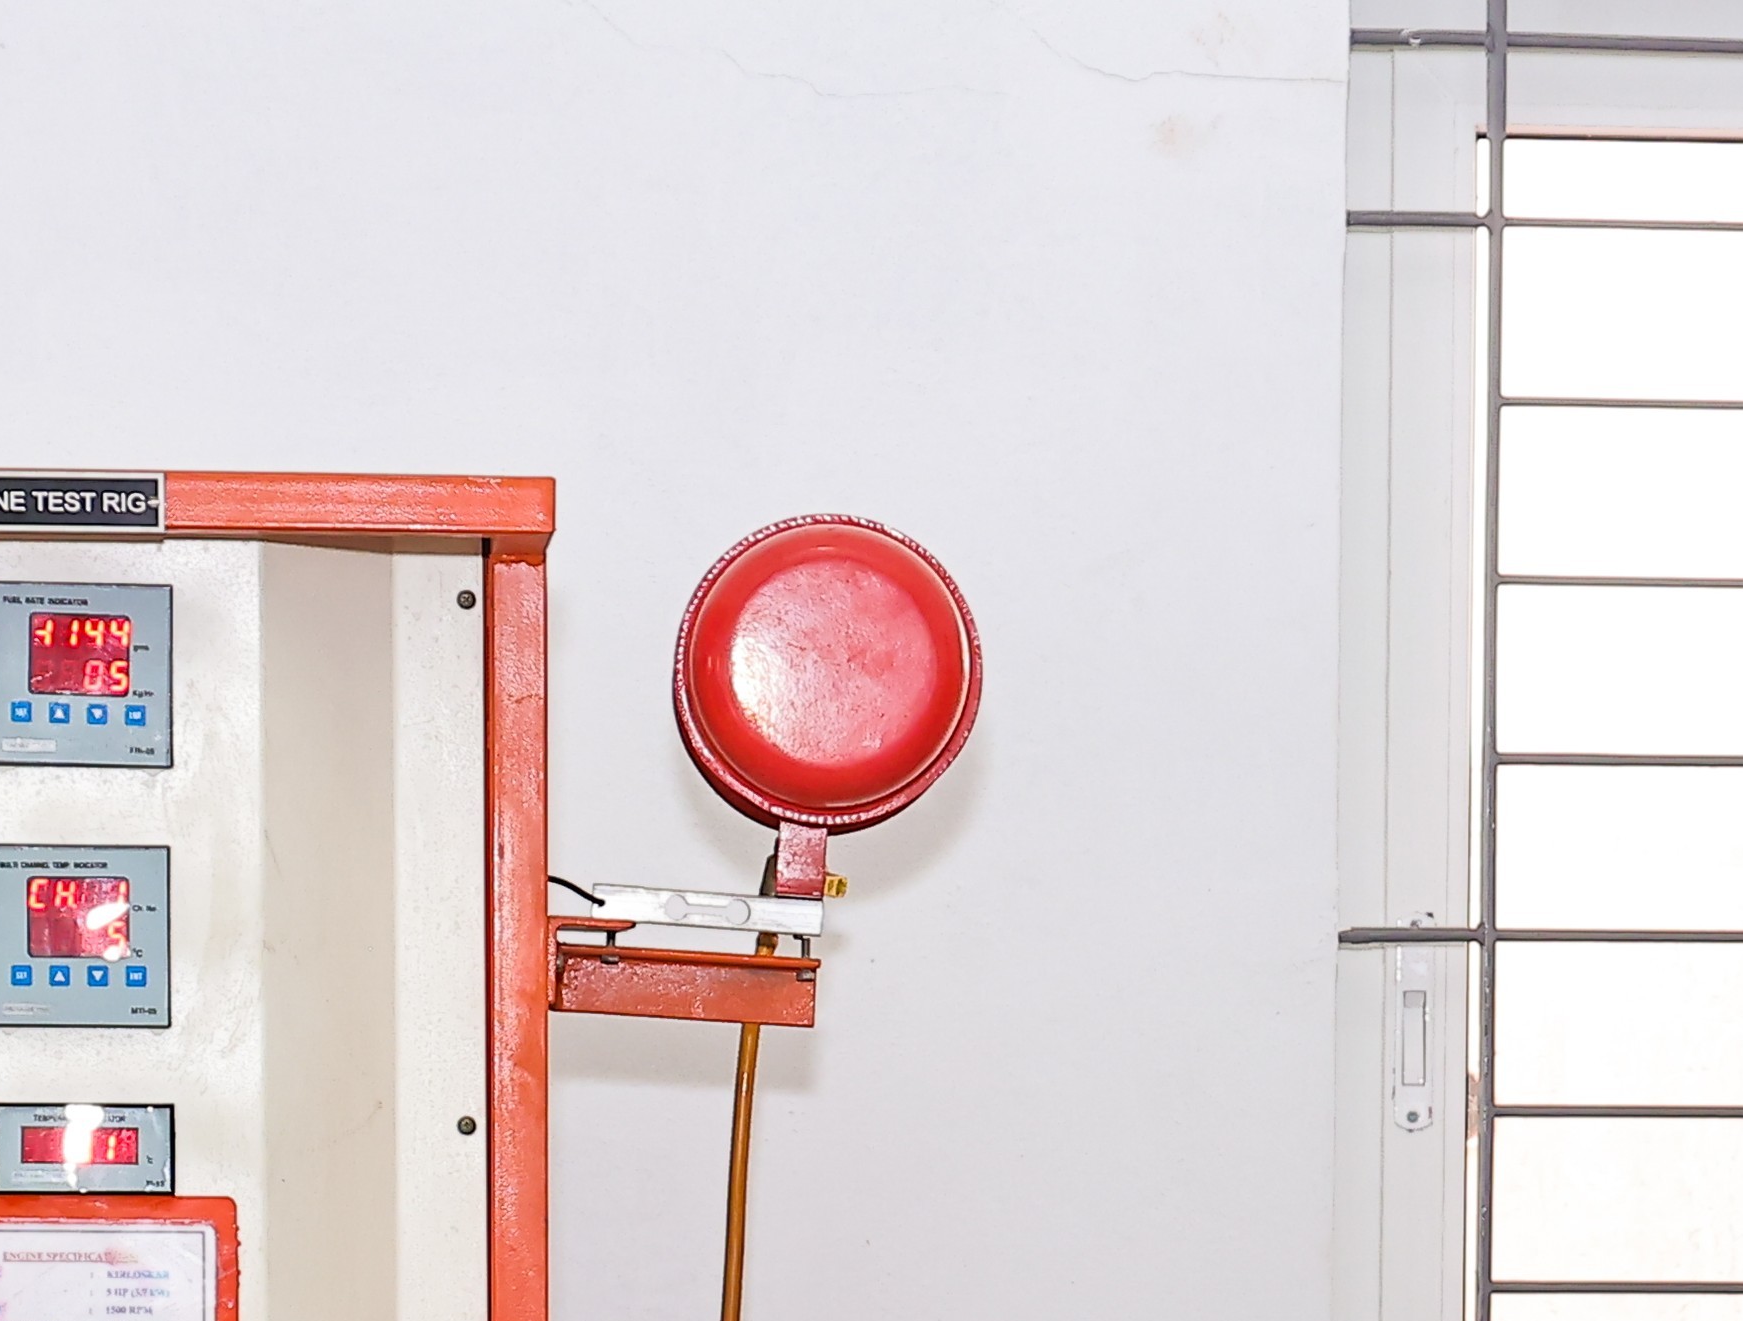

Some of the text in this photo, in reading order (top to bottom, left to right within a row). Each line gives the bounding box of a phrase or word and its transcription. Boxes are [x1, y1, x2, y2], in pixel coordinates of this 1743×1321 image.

[33, 490, 96, 513] TEST
[103, 491, 146, 514] RIG
[3, 1251, 44, 1261] ENGINE
[106, 1306, 126, 1314] 1500
